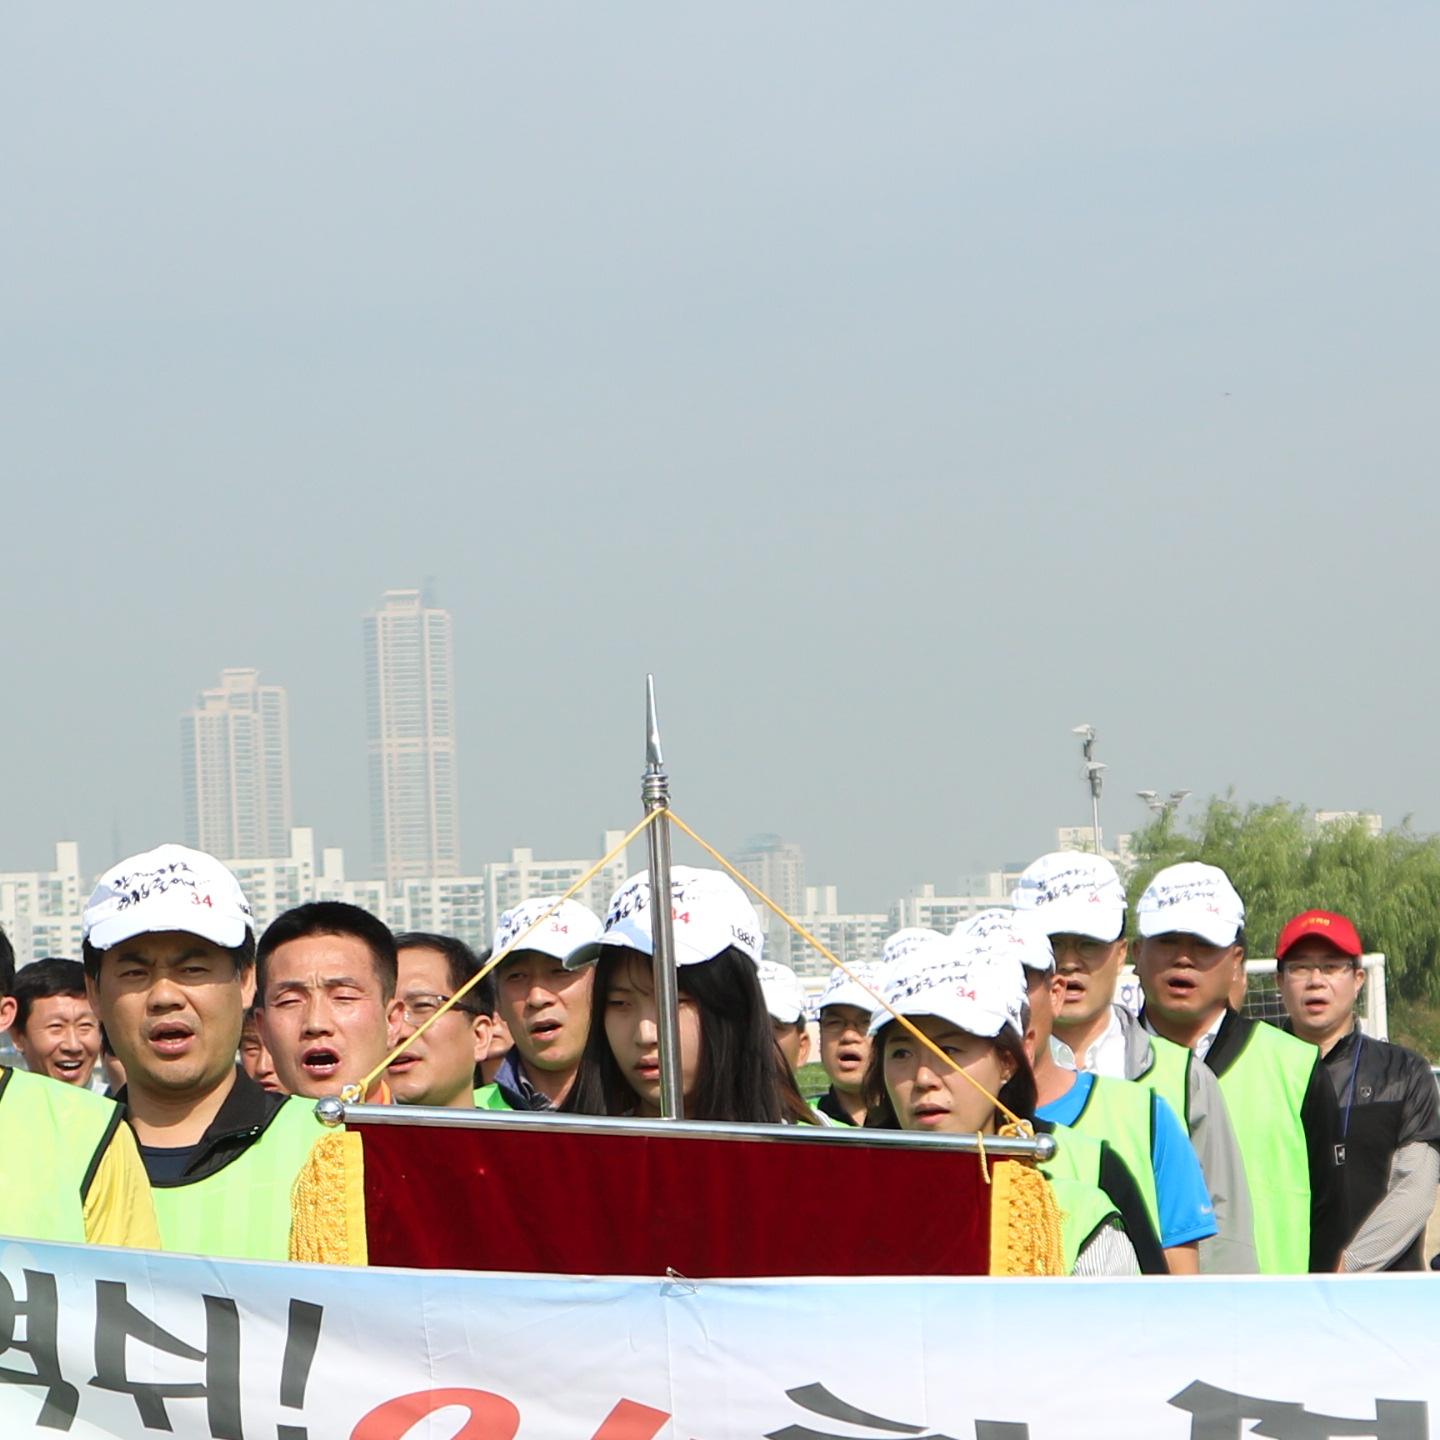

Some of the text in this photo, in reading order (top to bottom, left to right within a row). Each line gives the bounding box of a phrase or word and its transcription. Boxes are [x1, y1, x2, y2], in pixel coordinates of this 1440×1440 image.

[191, 892, 213, 908] 34
[551, 922, 568, 934] 34
[1007, 934, 1024, 945] 34
[956, 986, 976, 1001] 34
